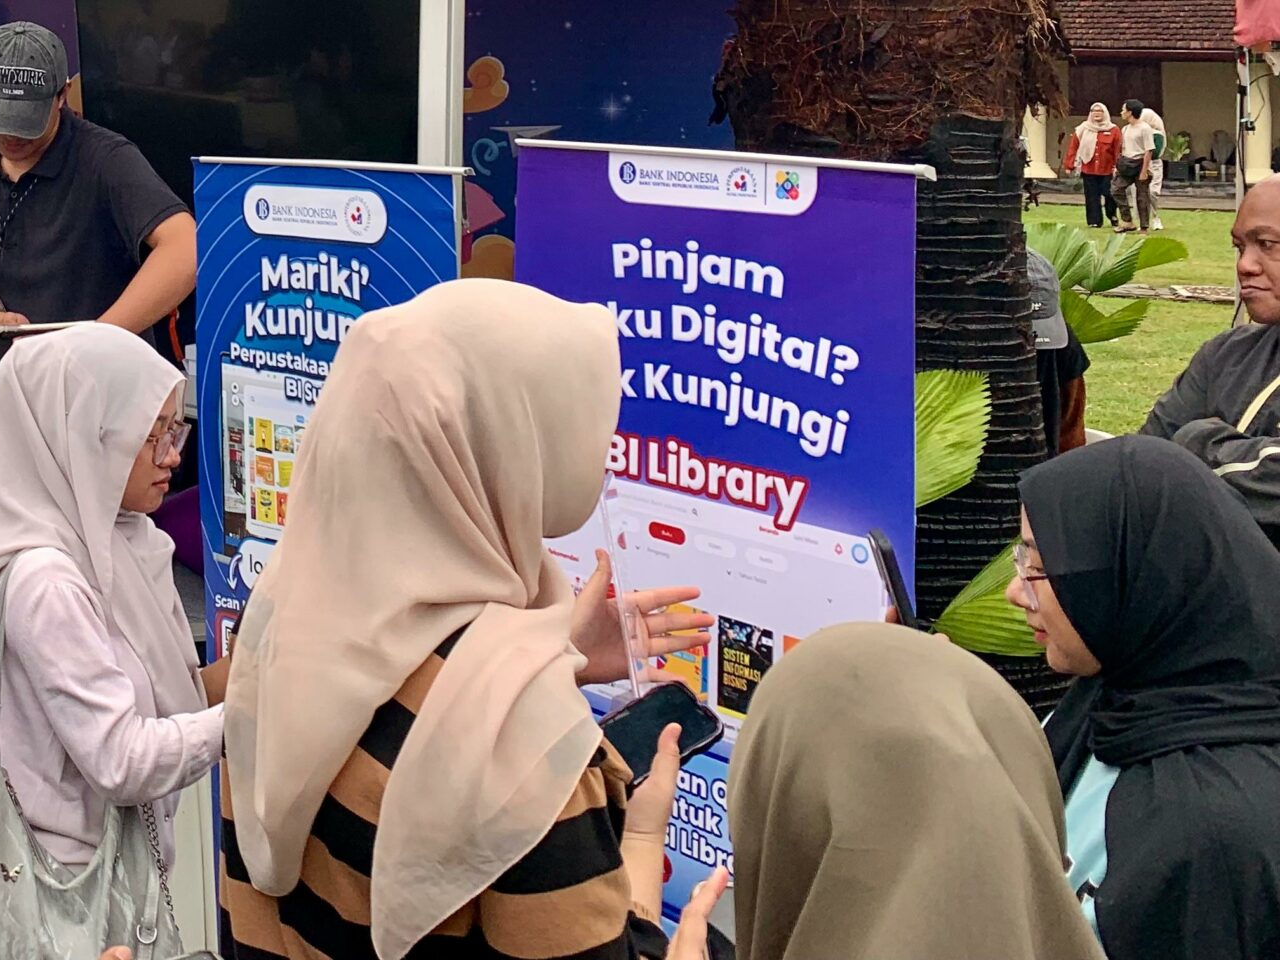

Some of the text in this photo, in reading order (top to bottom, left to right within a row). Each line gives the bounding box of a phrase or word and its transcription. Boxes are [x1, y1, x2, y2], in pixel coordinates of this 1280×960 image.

[639, 169, 720, 184] BANK INDONESIA
[272, 205, 337, 220] BANK INDONESIA
[611, 238, 784, 298] Pinjam
[672, 304, 859, 385] Digital?
[230, 342, 333, 376] Perpustakaa
[285, 378, 302, 399] BI
[643, 363, 850, 457] Kunjungi
[648, 440, 806, 527] Library
[215, 594, 240, 611] Scan
[723, 647, 750, 665] SISTEM
[723, 672, 747, 691] BISNIS
